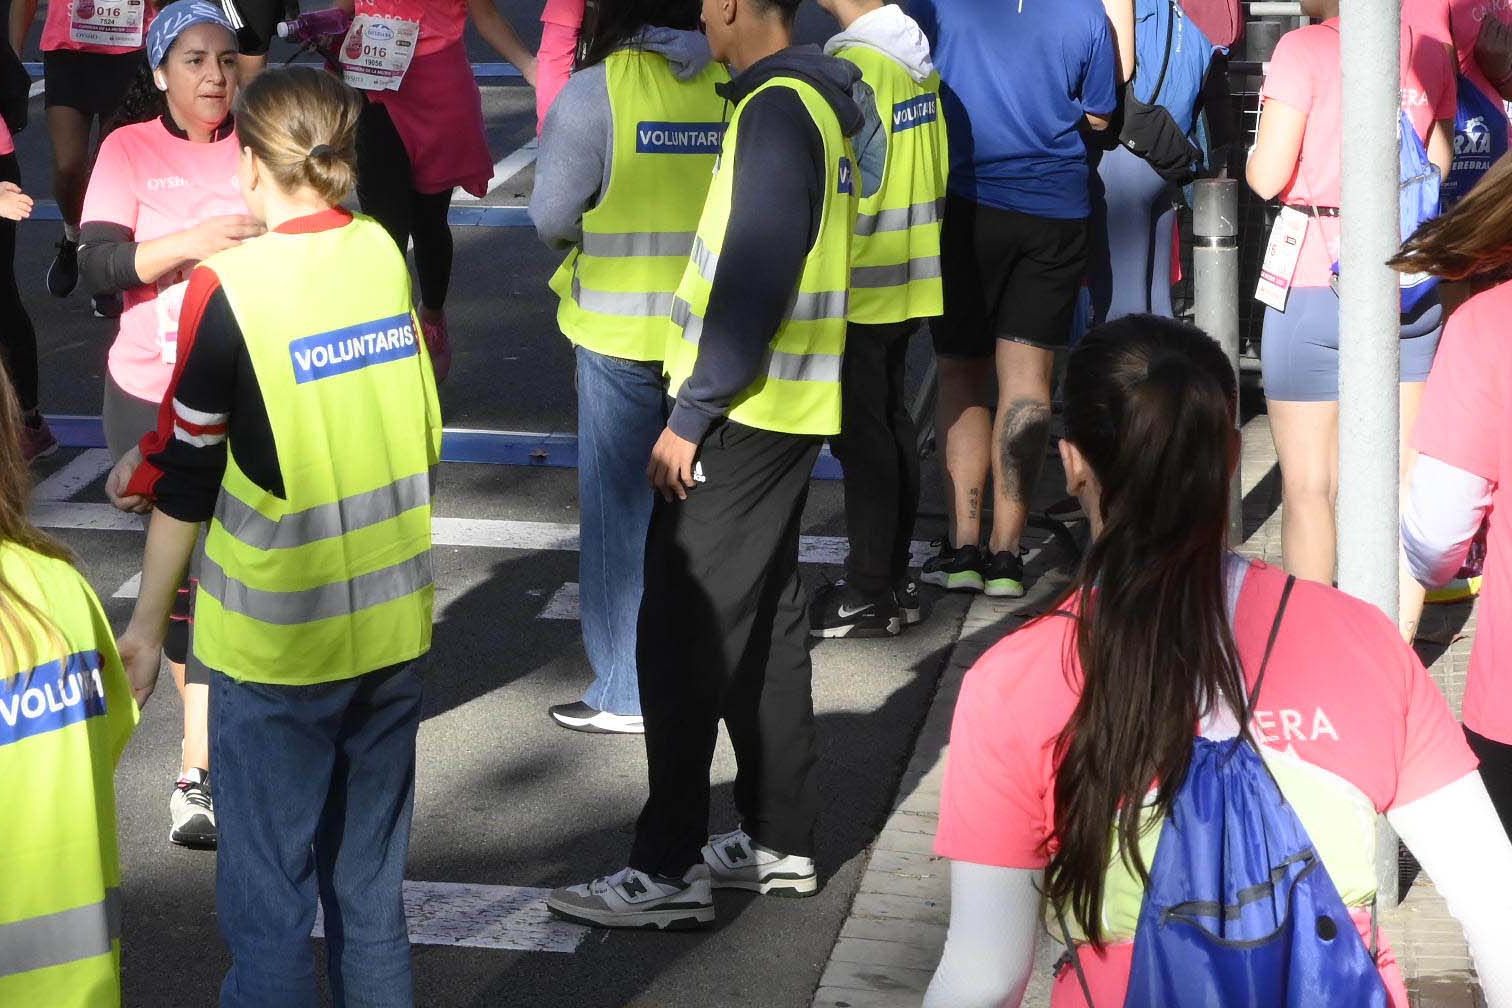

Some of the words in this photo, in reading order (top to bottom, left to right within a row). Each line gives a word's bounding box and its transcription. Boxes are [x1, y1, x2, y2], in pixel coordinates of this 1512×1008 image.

[96, 6, 121, 17] 016
[363, 45, 387, 58] 016
[639, 130, 725, 148] VOLUNTARI
[295, 326, 414, 371] VOLUNTARIS
